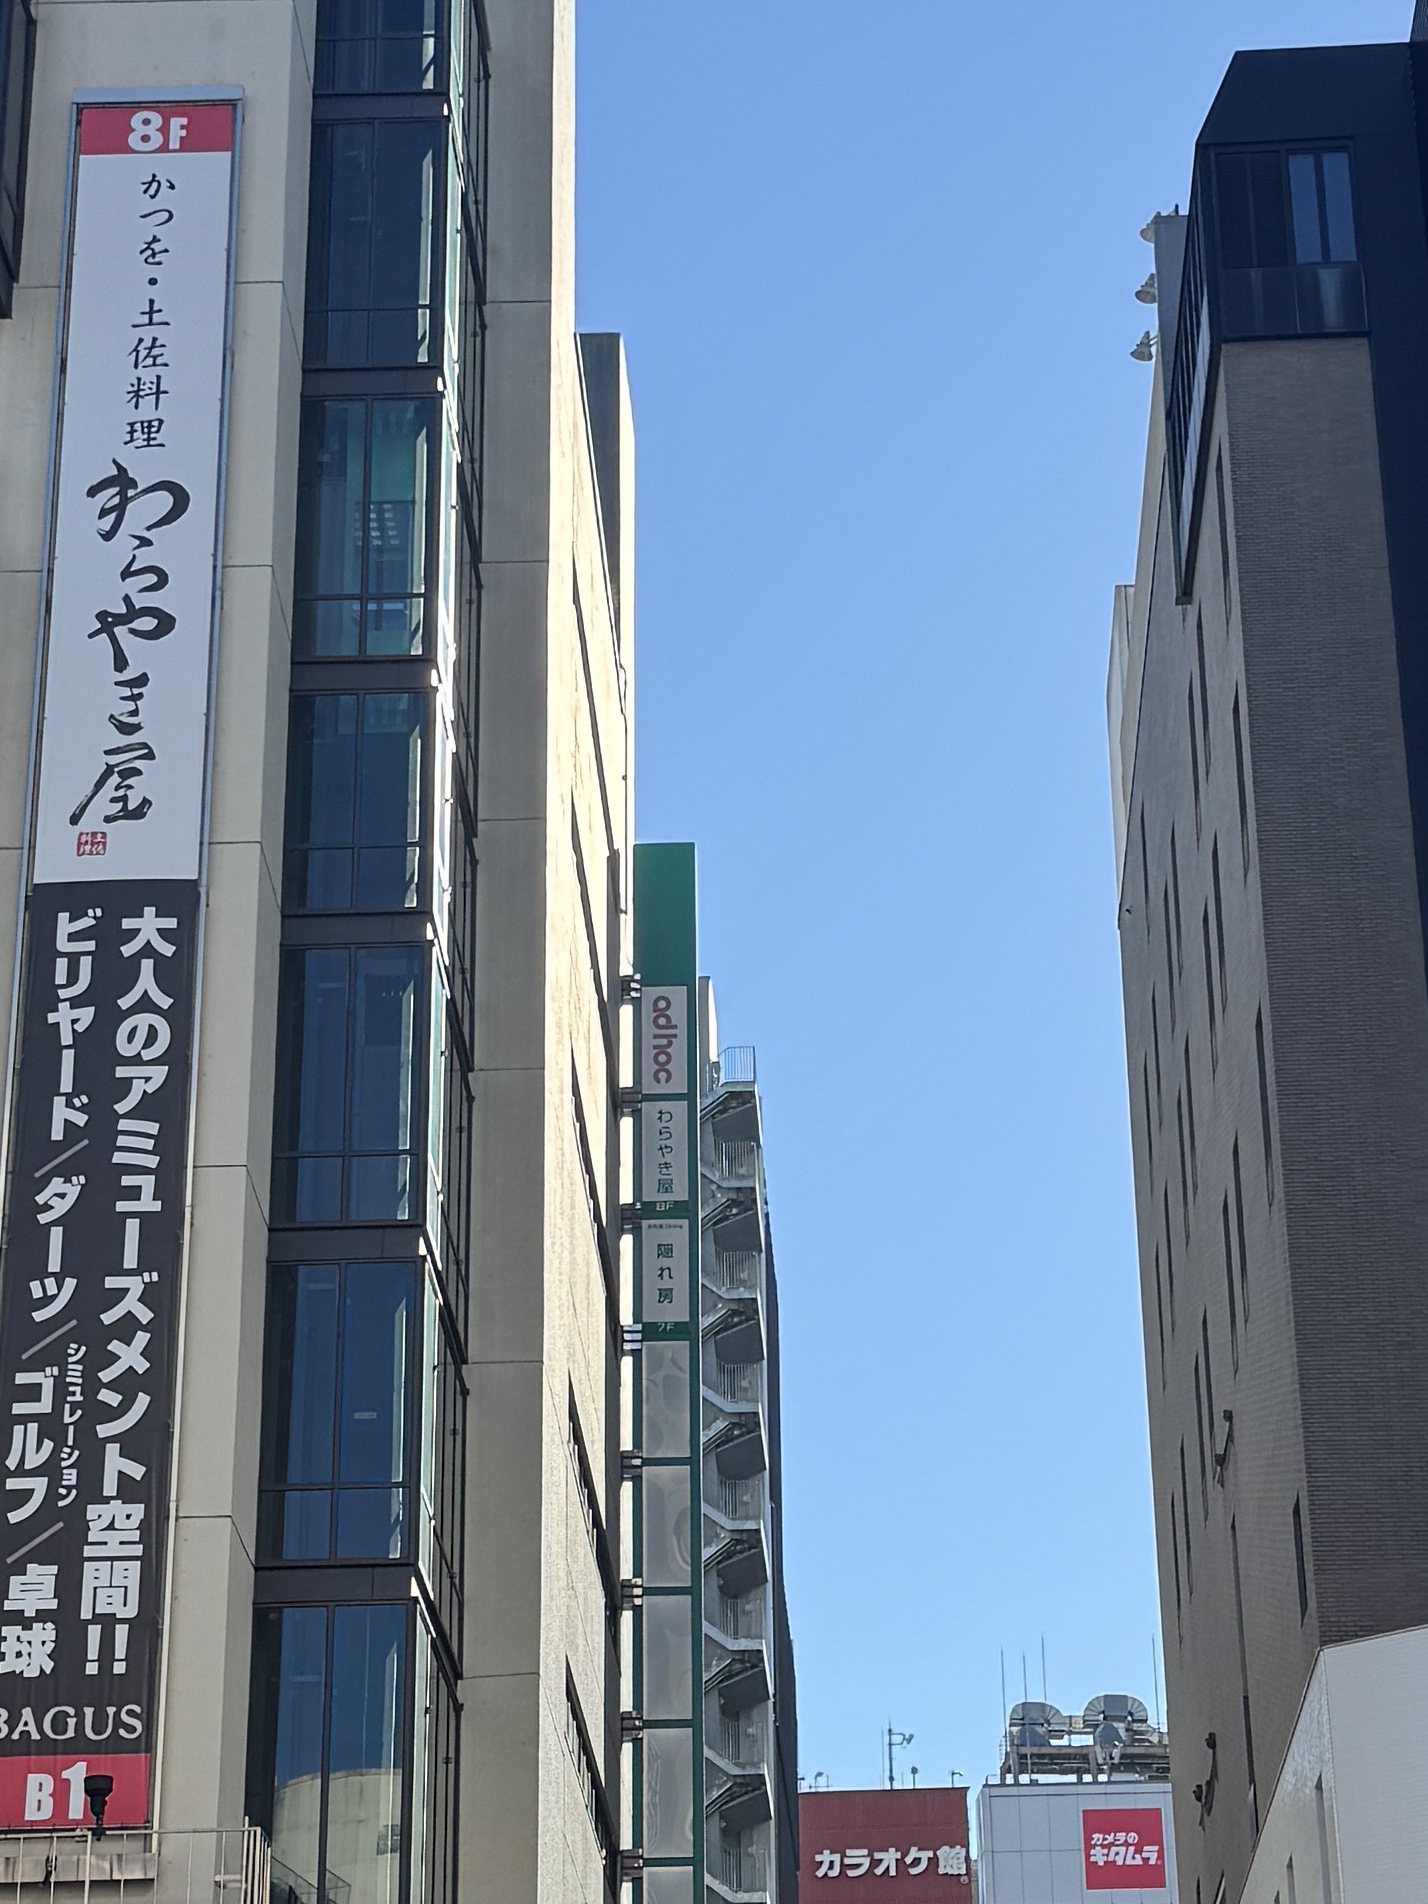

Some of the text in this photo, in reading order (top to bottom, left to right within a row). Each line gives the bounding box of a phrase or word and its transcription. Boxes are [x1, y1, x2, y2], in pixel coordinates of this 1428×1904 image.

[127, 111, 189, 152] 8F
[69, 457, 191, 827] わらやき屋
[652, 996, 678, 1084] adhoc
[657, 1109, 674, 1194] わらやき屋
[23, 1762, 88, 1820] B1
[814, 1845, 967, 1879] カラオケ館
[1089, 1845, 1160, 1866] キタムラ
[1091, 1832, 1138, 1846] カメラの
